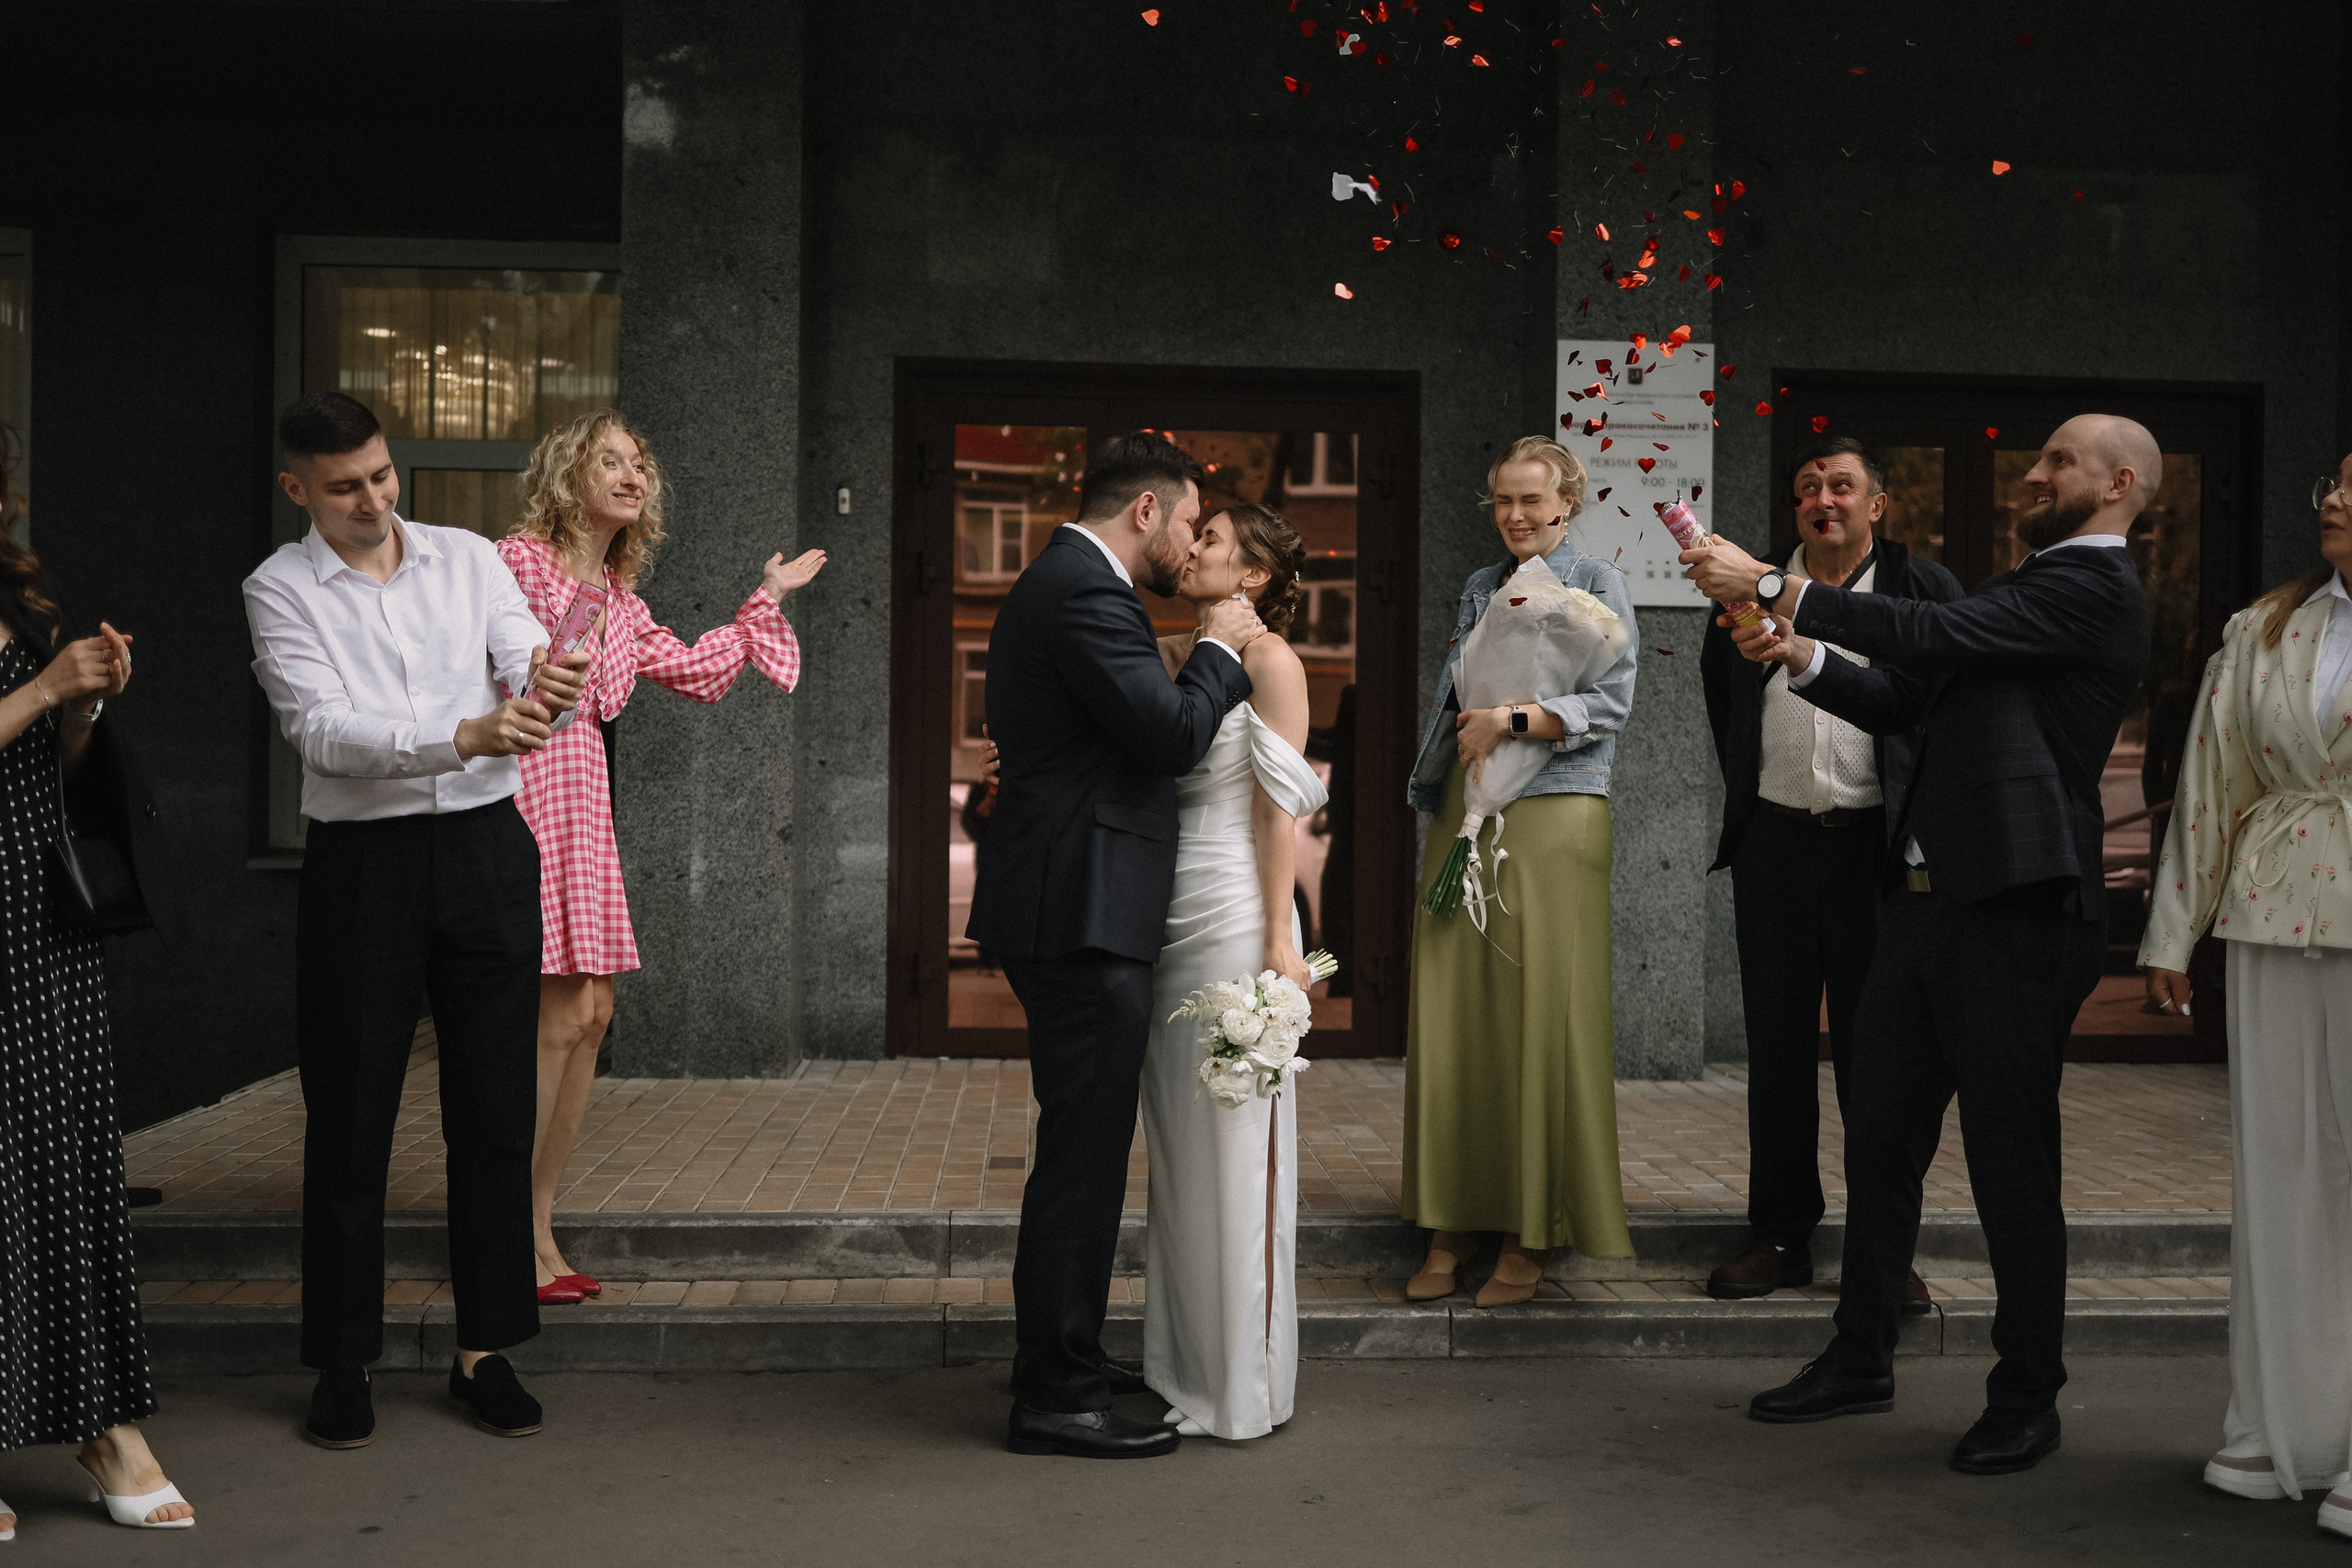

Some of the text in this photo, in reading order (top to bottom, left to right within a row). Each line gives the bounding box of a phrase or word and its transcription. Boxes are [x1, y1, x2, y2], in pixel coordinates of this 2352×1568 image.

[1702, 423, 1709, 431] 3
[1589, 457, 1631, 468] РЕЖИМ
[1641, 477, 1665, 487] 9:00
[1677, 478, 1705, 488] 18:00
